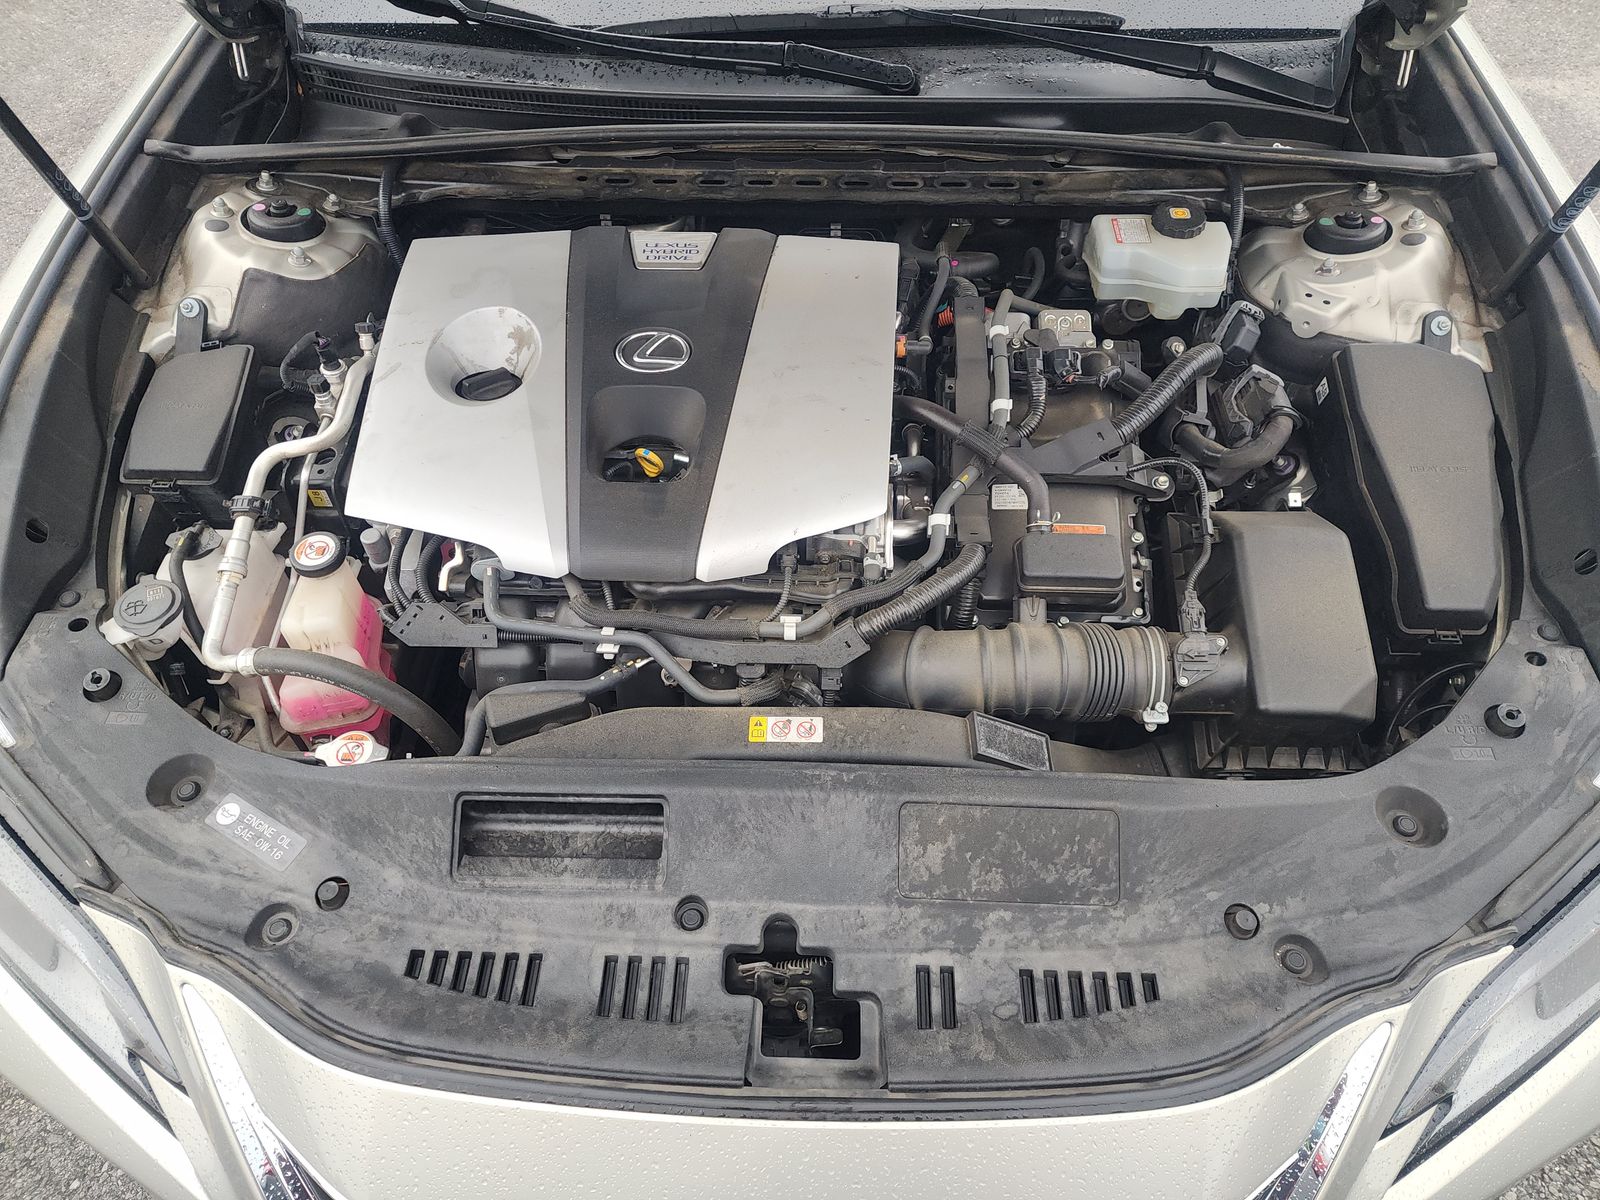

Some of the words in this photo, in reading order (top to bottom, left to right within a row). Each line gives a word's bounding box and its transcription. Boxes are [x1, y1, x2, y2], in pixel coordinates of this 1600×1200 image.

[234, 825, 255, 842] SAE
[255, 838, 284, 860] 0W-16
[243, 813, 277, 838] ENGINE
[277, 834, 292, 850] OIL
